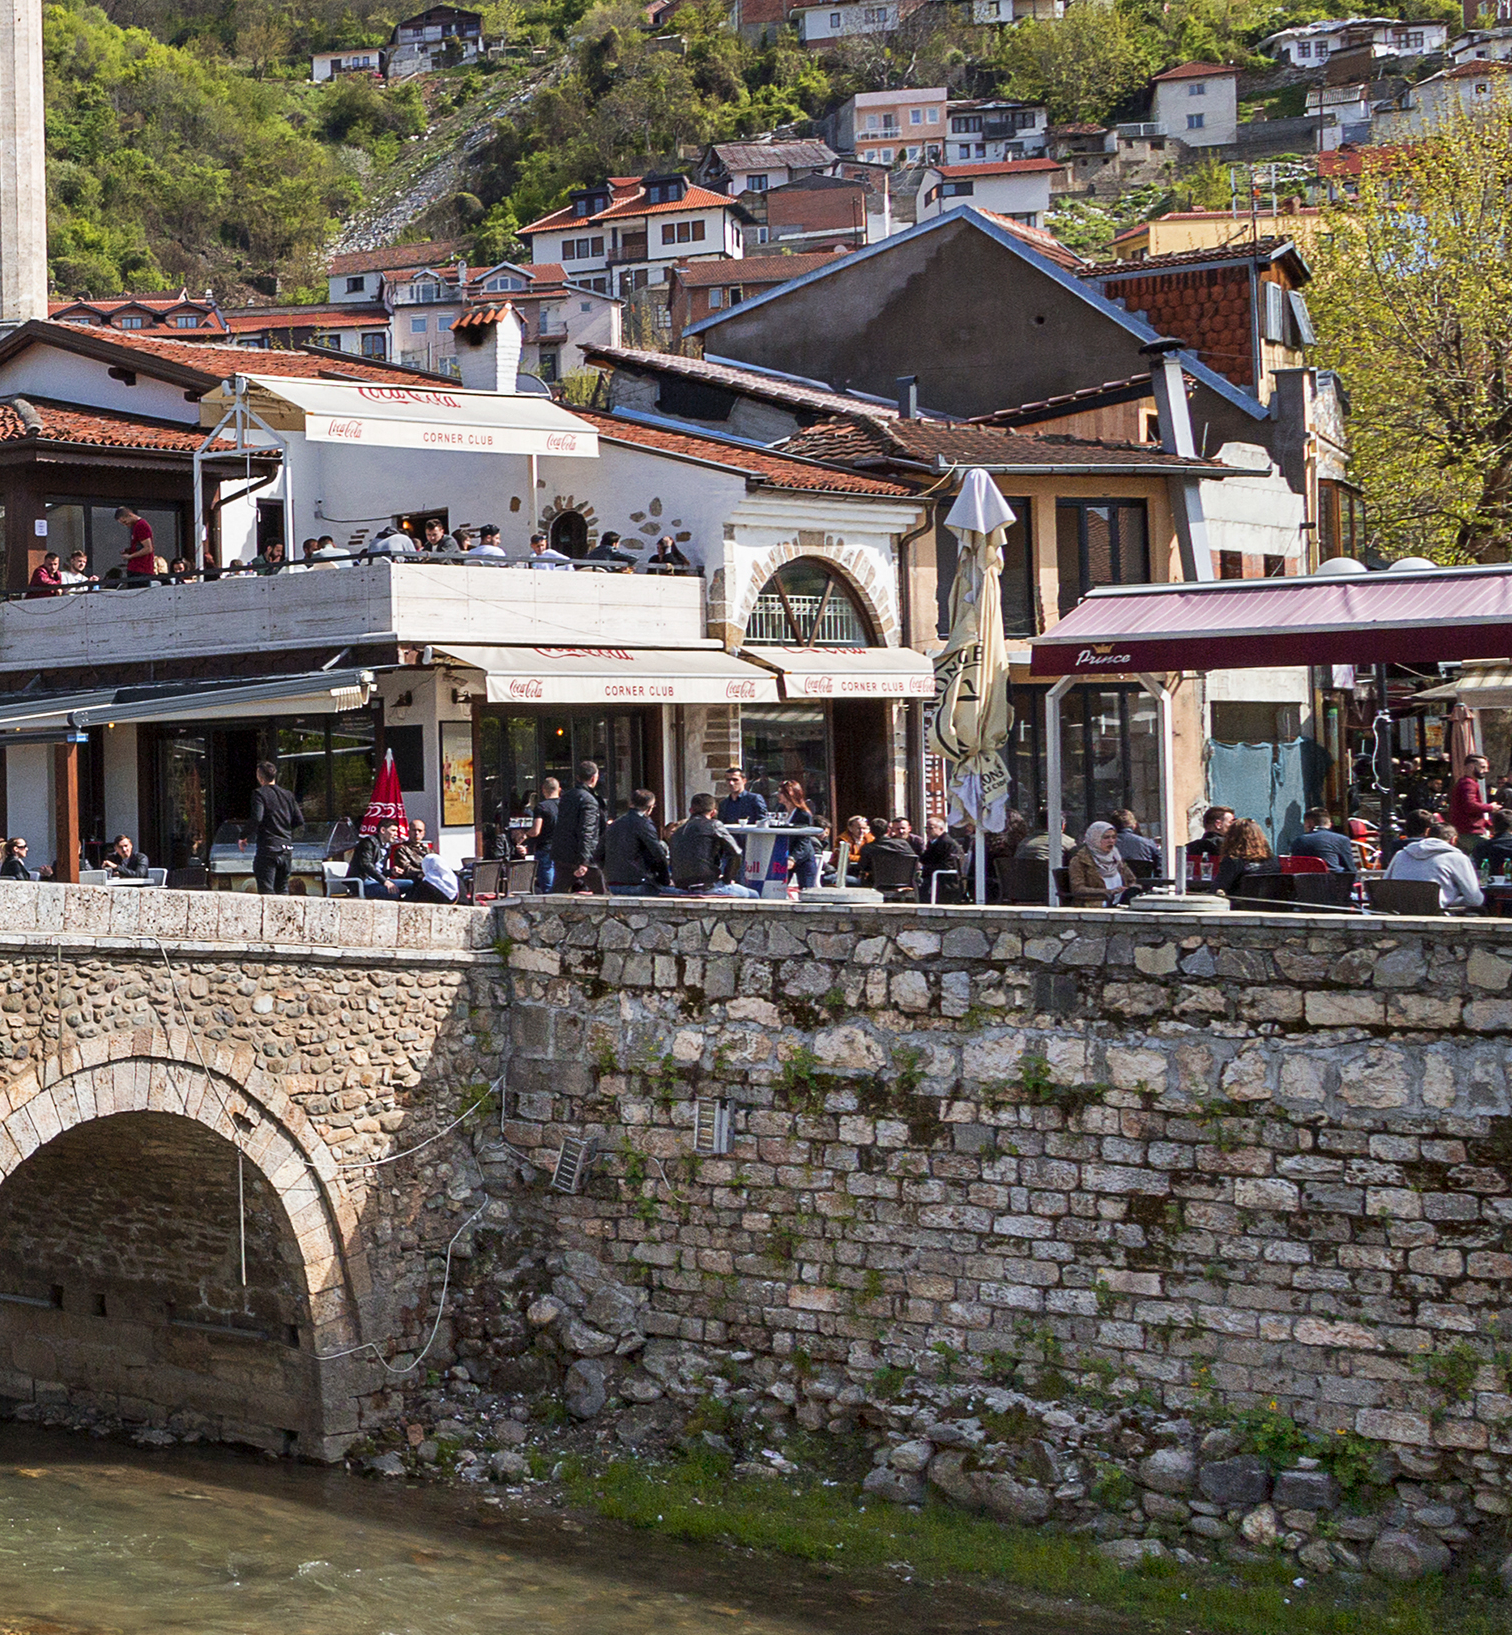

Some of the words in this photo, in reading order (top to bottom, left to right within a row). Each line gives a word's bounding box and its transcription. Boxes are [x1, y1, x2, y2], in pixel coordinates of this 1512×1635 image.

[422, 431, 464, 444] CORNER
[468, 434, 494, 446] CLUB
[1075, 649, 1131, 667] Prince
[604, 685, 645, 697] CORNER
[649, 685, 675, 697] CLUB
[841, 681, 877, 692] CORNER
[881, 681, 905, 692] CLUB
[745, 861, 760, 873] ull
[772, 862, 788, 874] Re
